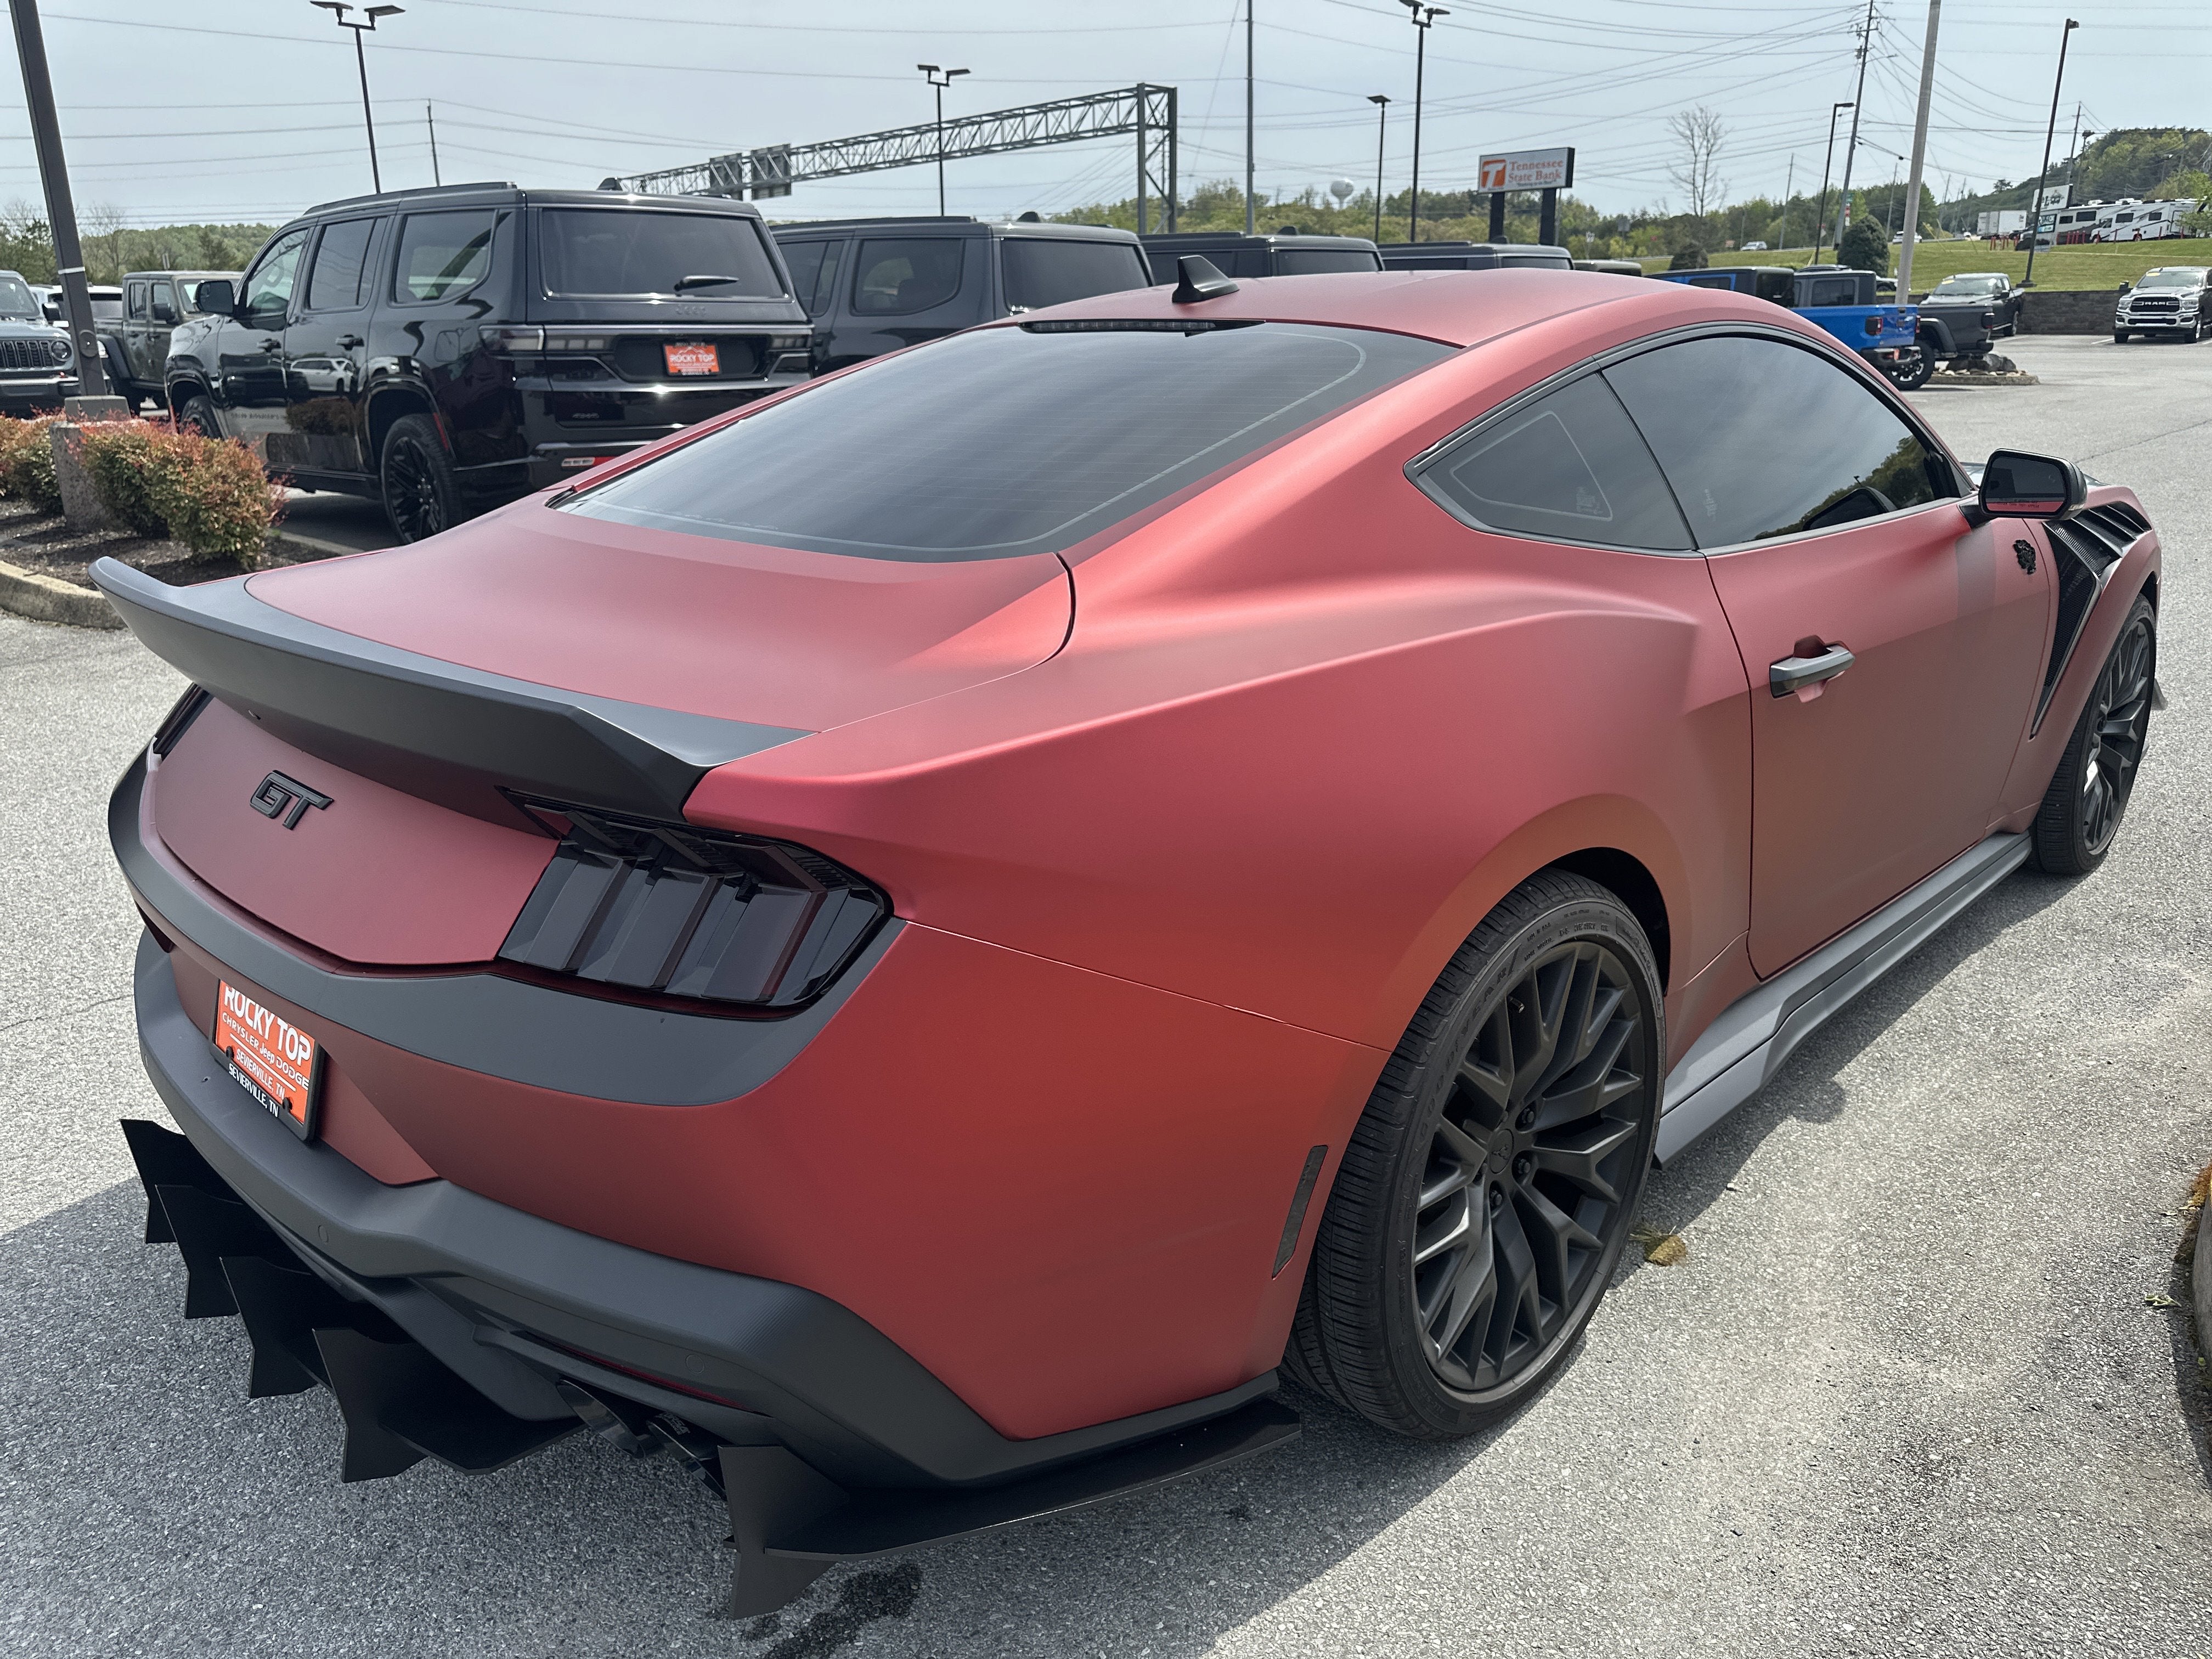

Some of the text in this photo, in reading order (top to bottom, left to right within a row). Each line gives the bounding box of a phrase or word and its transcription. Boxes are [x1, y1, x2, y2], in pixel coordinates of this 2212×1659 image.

[1509, 159, 1563, 171] Tennessee
[1509, 169, 1562, 182] State Bank
[675, 303, 707, 317] Jeep
[670, 353, 714, 363] ROCKY TOP
[250, 770, 334, 831] GT
[224, 985, 311, 1066] ROCKY TOP
[222, 1012, 309, 1091] CHRYSLER Jeep DODGE
[236, 1048, 285, 1099] SEVIERVILLE, TN
[229, 1063, 279, 1118] SEVIERVILLE, TN
